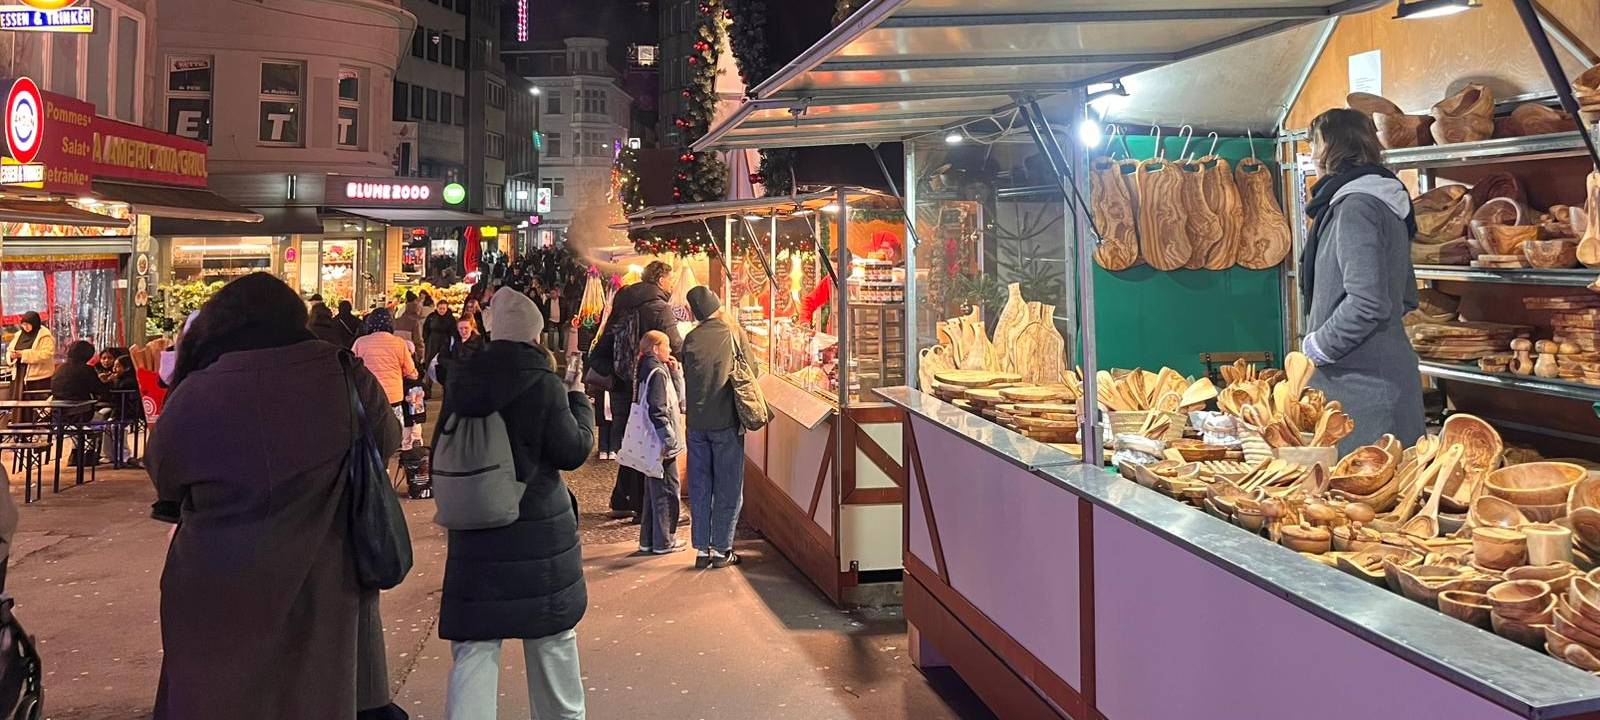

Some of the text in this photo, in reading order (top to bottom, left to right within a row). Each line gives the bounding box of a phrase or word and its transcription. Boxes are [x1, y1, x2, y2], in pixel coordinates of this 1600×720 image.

[0, 10, 91, 27] ESSEN & TRINKEN
[47, 101, 88, 126] Pommes
[175, 110, 202, 138] E
[267, 113, 291, 141] T
[62, 136, 87, 156] Salat
[103, 134, 178, 174] AMERICANA
[178, 149, 208, 178] GRILL
